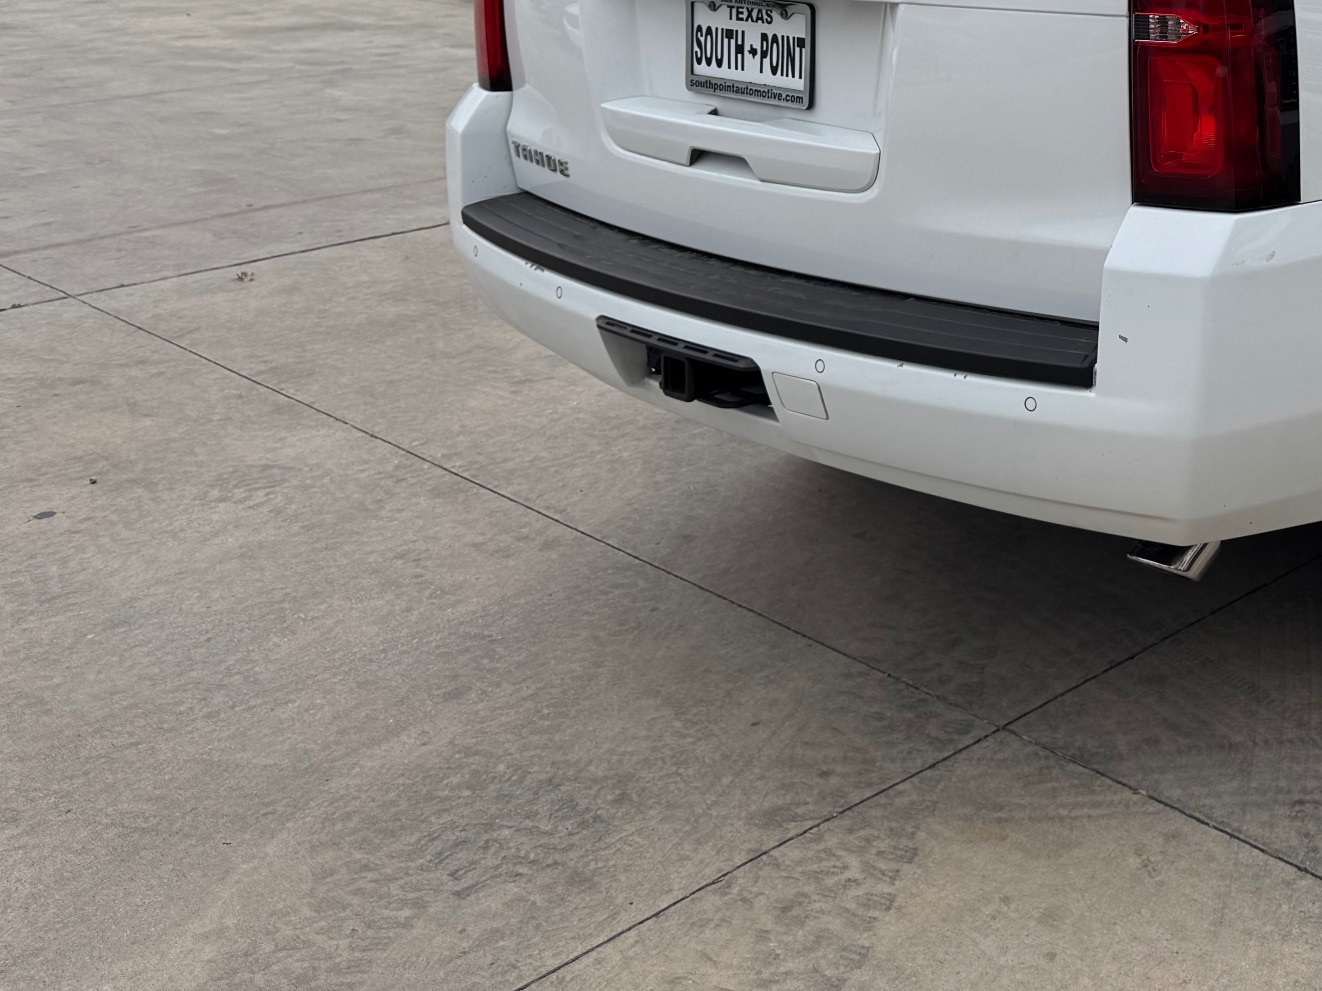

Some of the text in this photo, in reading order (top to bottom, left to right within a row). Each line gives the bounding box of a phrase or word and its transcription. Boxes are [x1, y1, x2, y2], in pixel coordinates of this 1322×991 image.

[727, 5, 774, 25] TEXAS
[695, 24, 806, 79] SOUTH POINT
[690, 78, 804, 104] southpointautomotive.com
[511, 140, 570, 178] TAHOE
